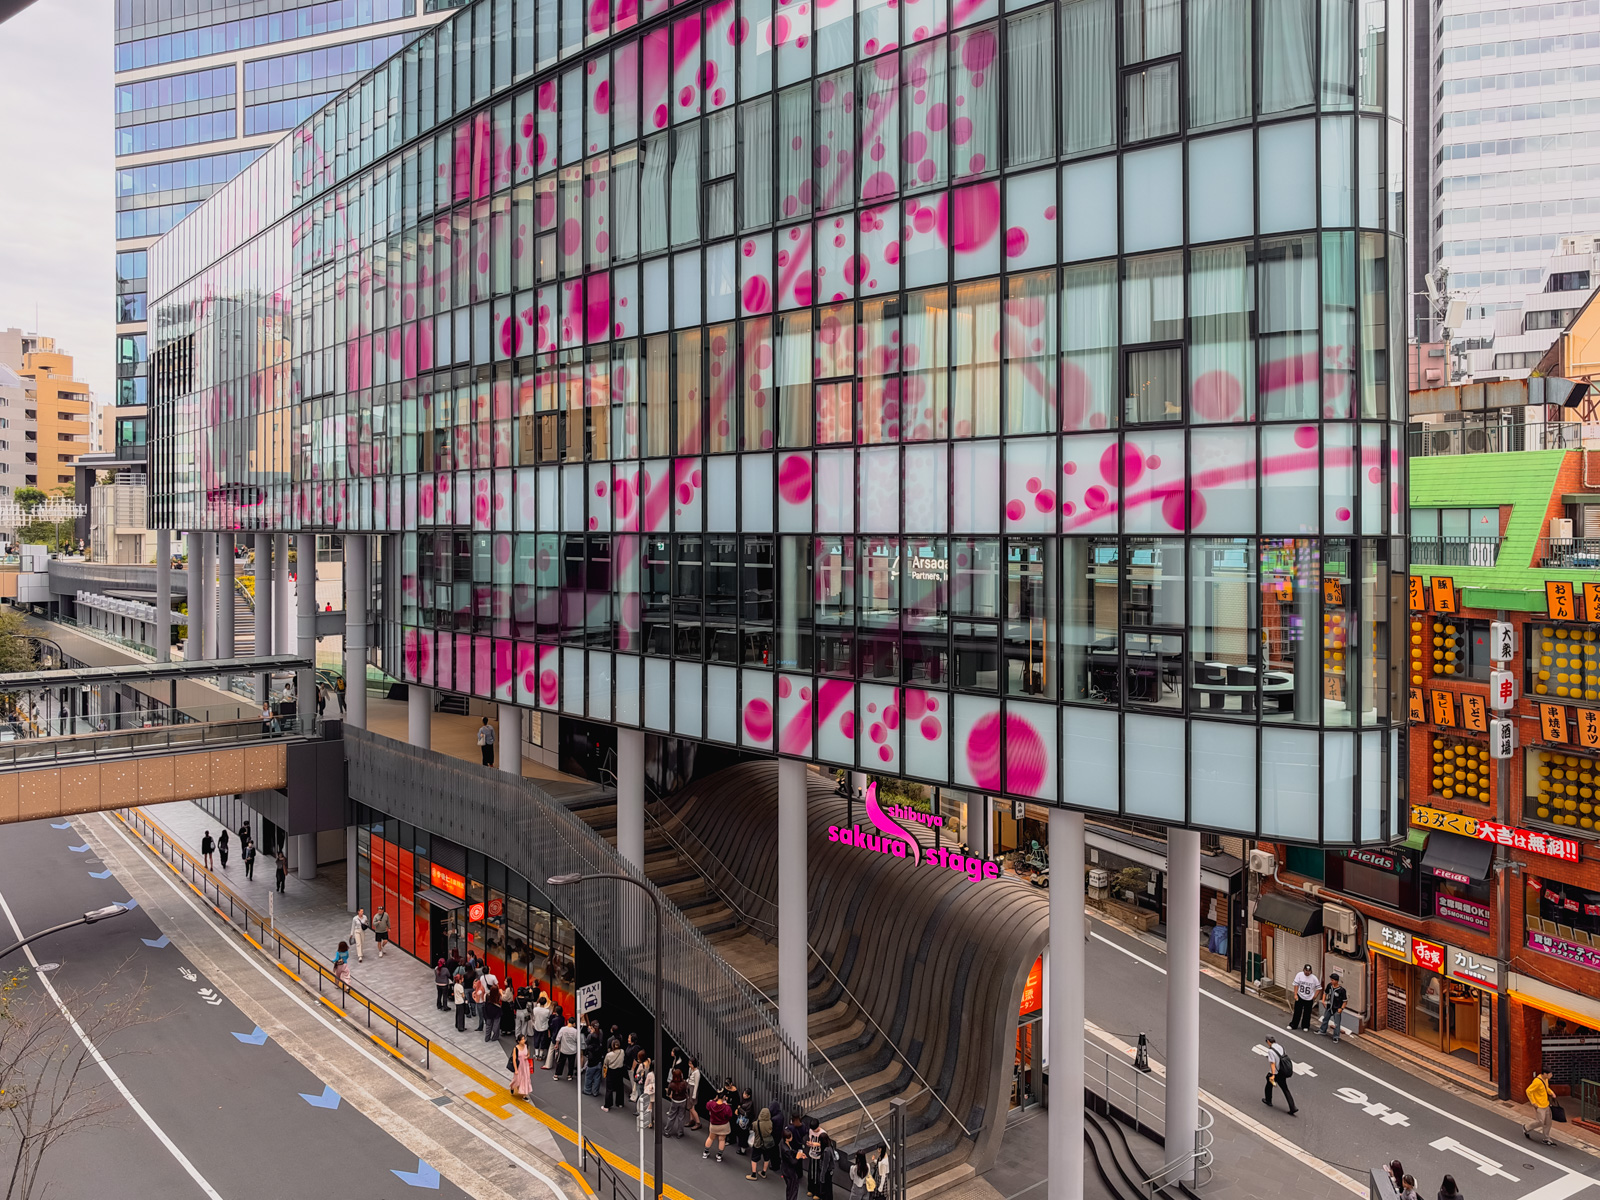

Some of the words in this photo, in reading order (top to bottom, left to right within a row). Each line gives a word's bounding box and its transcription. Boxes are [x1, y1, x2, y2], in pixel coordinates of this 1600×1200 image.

[912, 571, 942, 582] Partners,
[1437, 579, 1450, 609] 豚玉
[1555, 584, 1568, 617] おでん
[1501, 626, 1512, 658] 大衆
[1500, 678, 1513, 704] 串
[1437, 693, 1449, 725] 生ビール
[1469, 697, 1481, 728] 牛どて
[1547, 706, 1561, 739] 串焼き
[1501, 723, 1512, 755] 酒場
[1585, 712, 1599, 745] 串カツ
[887, 804, 943, 827] shibuya
[1416, 808, 1478, 836] おみくじ
[828, 824, 906, 859] sakura
[926, 846, 999, 883] stage
[1350, 849, 1392, 868] Fields
[1435, 868, 1468, 883] Fields
[1447, 910, 1474, 923] SMOKING
[1381, 926, 1406, 946] 牛丼
[1415, 941, 1440, 965] すき家
[1454, 952, 1495, 972] カレー
[1464, 969, 1486, 981] CURRY
[581, 983, 600, 995] TAXI
